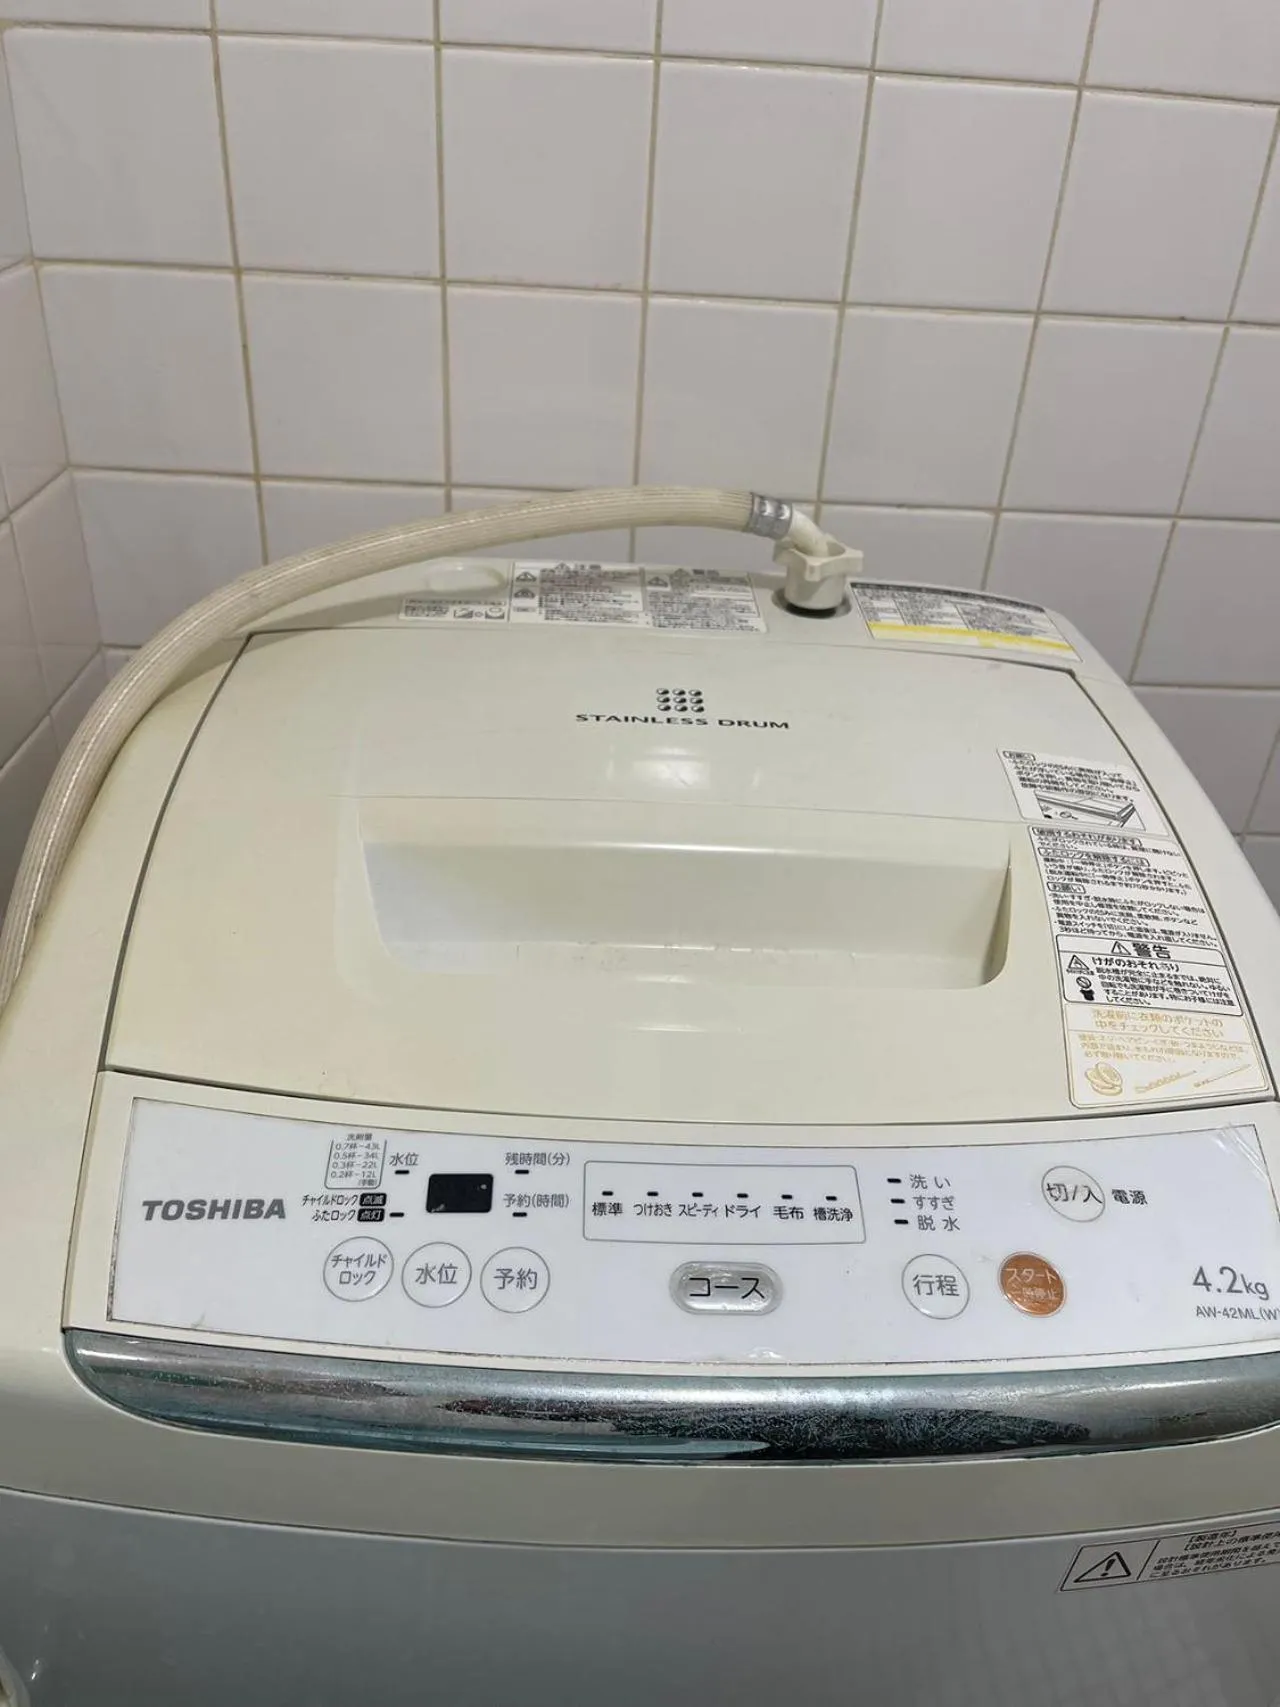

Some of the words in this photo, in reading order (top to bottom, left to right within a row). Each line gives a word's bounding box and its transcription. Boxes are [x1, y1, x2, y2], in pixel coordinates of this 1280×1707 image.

[576, 714, 709, 725] STAINLESS
[718, 719, 789, 729] DRUM
[1052, 884, 1082, 893] お願い
[1133, 942, 1171, 959] 警告
[1092, 957, 1179, 972] けがのおそれあり
[1106, 996, 1151, 1006] してください。
[1095, 1020, 1223, 1038] 中をチェックしてください
[389, 1152, 419, 1166] 水位
[505, 1152, 570, 1167] 残時間(分)
[910, 1174, 951, 1190] 洗い
[302, 1194, 358, 1207] チャイルドロック
[361, 1194, 386, 1206] 点滅
[503, 1193, 570, 1209] 予約(時間)
[1046, 1183, 1104, 1204] 切/入
[1112, 1188, 1148, 1205] 電源
[142, 1198, 286, 1221] TOSHIBA
[913, 1195, 955, 1211] すすぎ
[312, 1209, 357, 1222] ふたロック
[359, 1209, 384, 1221] 点灯
[592, 1203, 623, 1217] 標準
[633, 1203, 674, 1217] つけおき
[678, 1203, 719, 1218] スピーディ
[725, 1204, 762, 1219] ドライ
[773, 1206, 804, 1221] 毛布
[813, 1207, 854, 1222] 槽洗浄
[917, 1215, 961, 1232] 脱水
[331, 1253, 388, 1269] チャイルド
[339, 1270, 376, 1286] ロック
[415, 1263, 458, 1285] 水位
[493, 1268, 538, 1290] 予約
[1006, 1268, 1057, 1285] スタート
[690, 1277, 765, 1299] コース
[912, 1274, 960, 1297] 行程
[1193, 1266, 1269, 1301] 4.2kg
